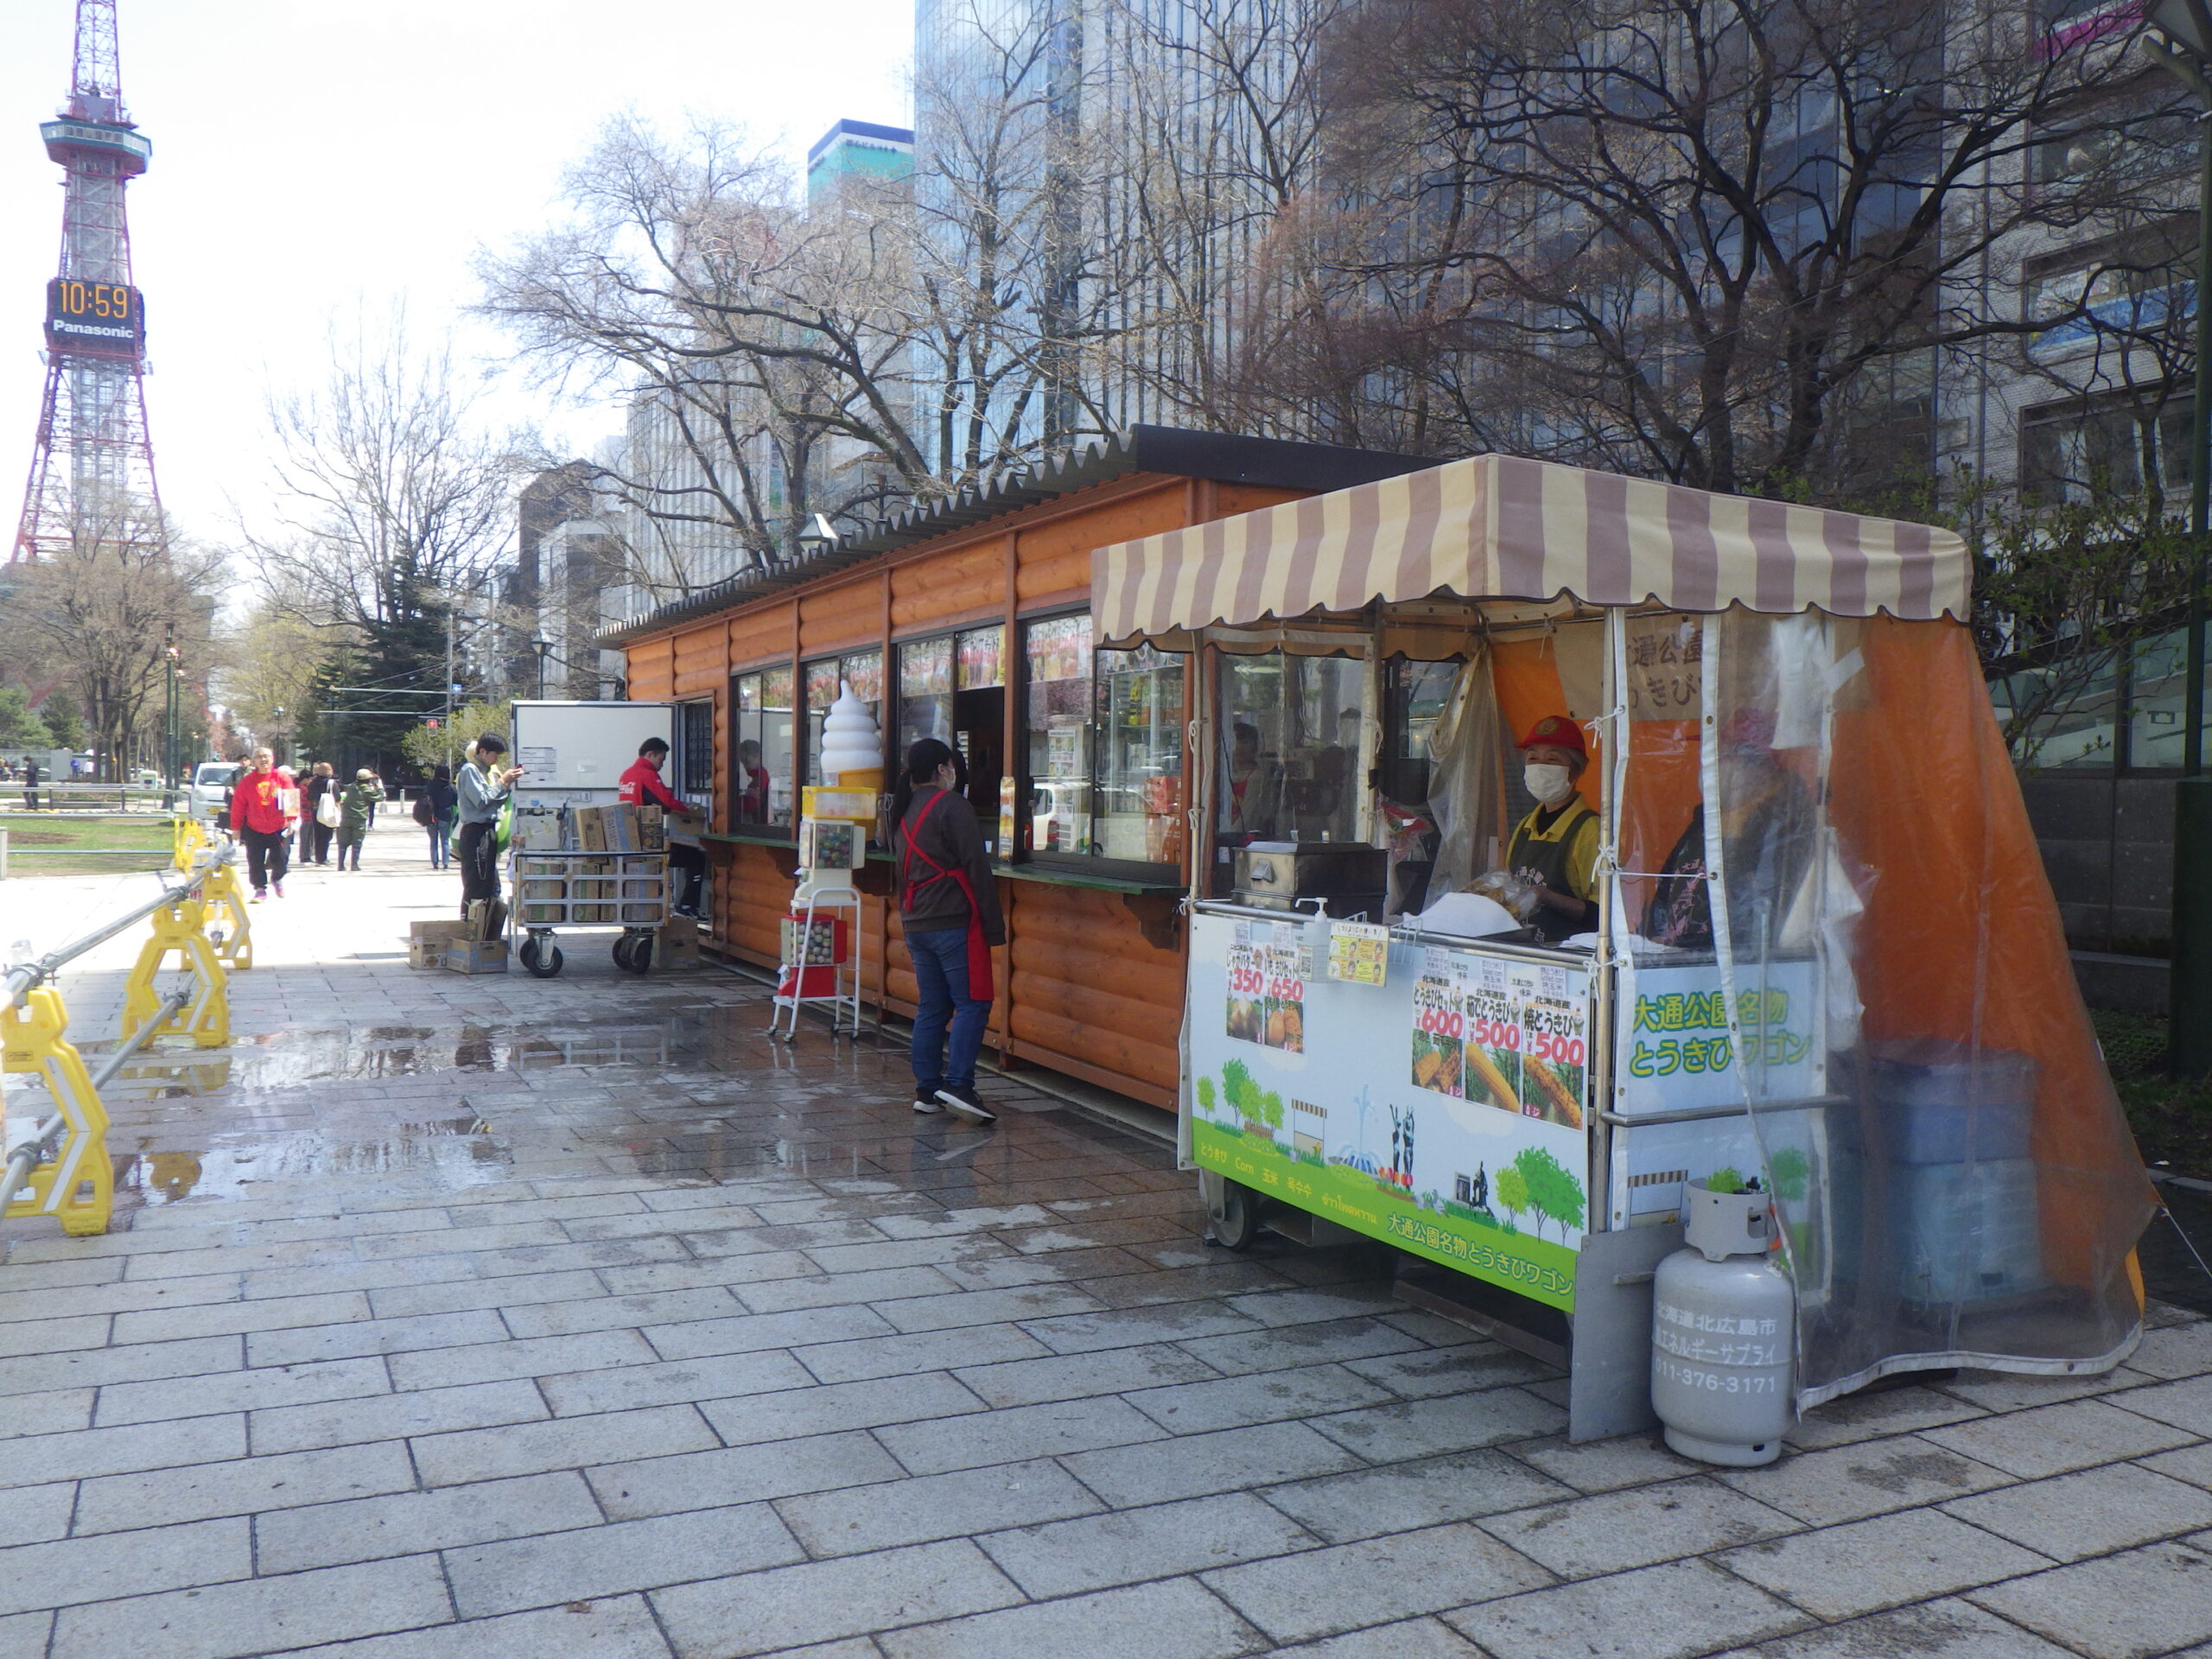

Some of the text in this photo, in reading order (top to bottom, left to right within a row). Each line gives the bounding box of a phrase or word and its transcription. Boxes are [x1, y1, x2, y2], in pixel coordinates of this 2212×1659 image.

[60, 283, 128, 319] 10:59
[53, 319, 135, 338] Panasonic
[1233, 968, 1263, 995] 350
[1271, 977, 1304, 1001] 650
[1422, 975, 1450, 987] 北海道産
[1476, 988, 1507, 1001] 北海道産
[1414, 987, 1455, 1012] とうきびセット
[1466, 995, 1510, 1023] 茹でとうきび
[1535, 995, 1571, 1009] 北海道産
[1633, 988, 1789, 1033] 大通公園名物
[1421, 1009, 1463, 1038] 600
[1475, 1019, 1520, 1051] 500
[1524, 1007, 1573, 1037] 焼とうきび
[1535, 1032, 1585, 1067] 500
[1630, 1027, 1814, 1079] とうきびワゴン
[1200, 1141, 1228, 1164] とうきび
[1235, 1157, 1255, 1175] Corn
[1286, 1176, 1313, 1198] 옥수수
[1388, 1211, 1575, 1296] 大通公園名物とうきびワゴン
[1656, 1300, 1777, 1337] 北海道北広島市
[1656, 1355, 1775, 1395] 011-376-3171
